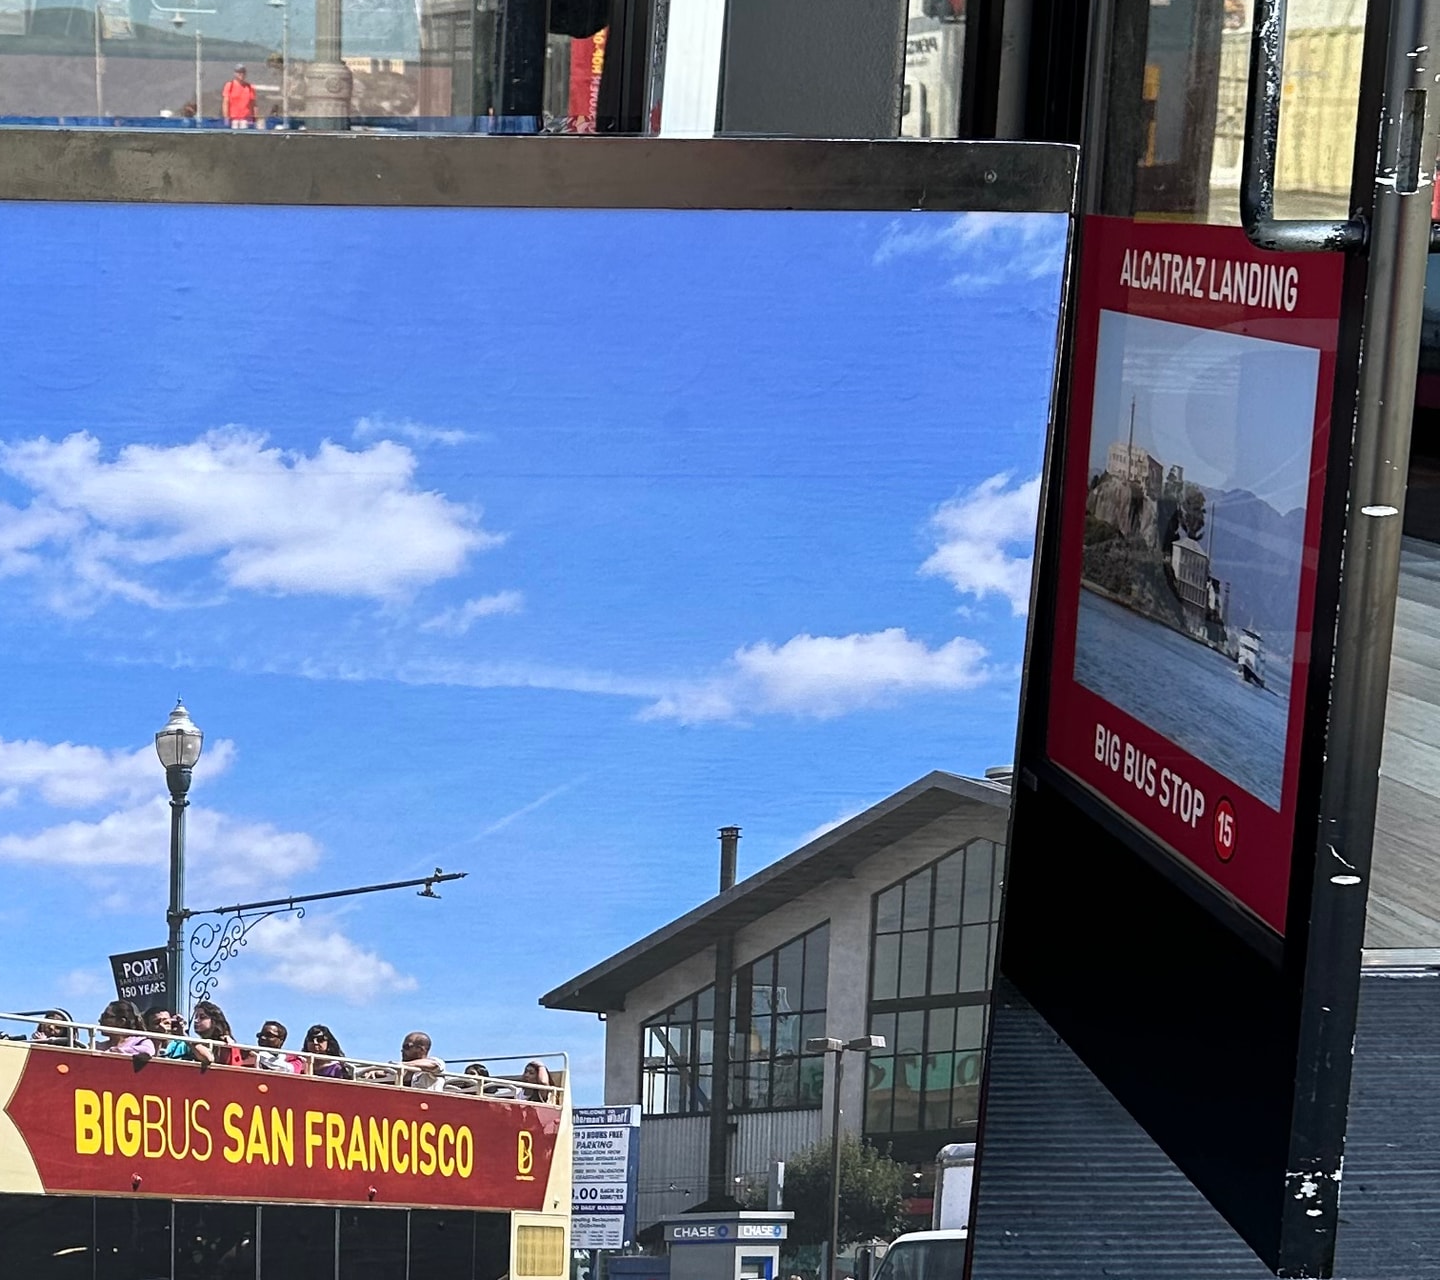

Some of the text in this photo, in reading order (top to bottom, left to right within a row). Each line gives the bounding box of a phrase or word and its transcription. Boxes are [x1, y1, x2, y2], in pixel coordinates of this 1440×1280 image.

[1120, 248, 1299, 312] ALCATRAZ LANDING
[1094, 723, 1205, 829] BIG BUS STOP
[1216, 810, 1234, 848] 15
[122, 958, 159, 979] PORT
[120, 981, 167, 998] 150 YEARS
[223, 1102, 295, 1167] SAN
[305, 1110, 474, 1179] FRANCISCO
[576, 1140, 613, 1150] PARKING
[673, 1226, 716, 1238] CHASE
[743, 1225, 773, 1236] CHASE
